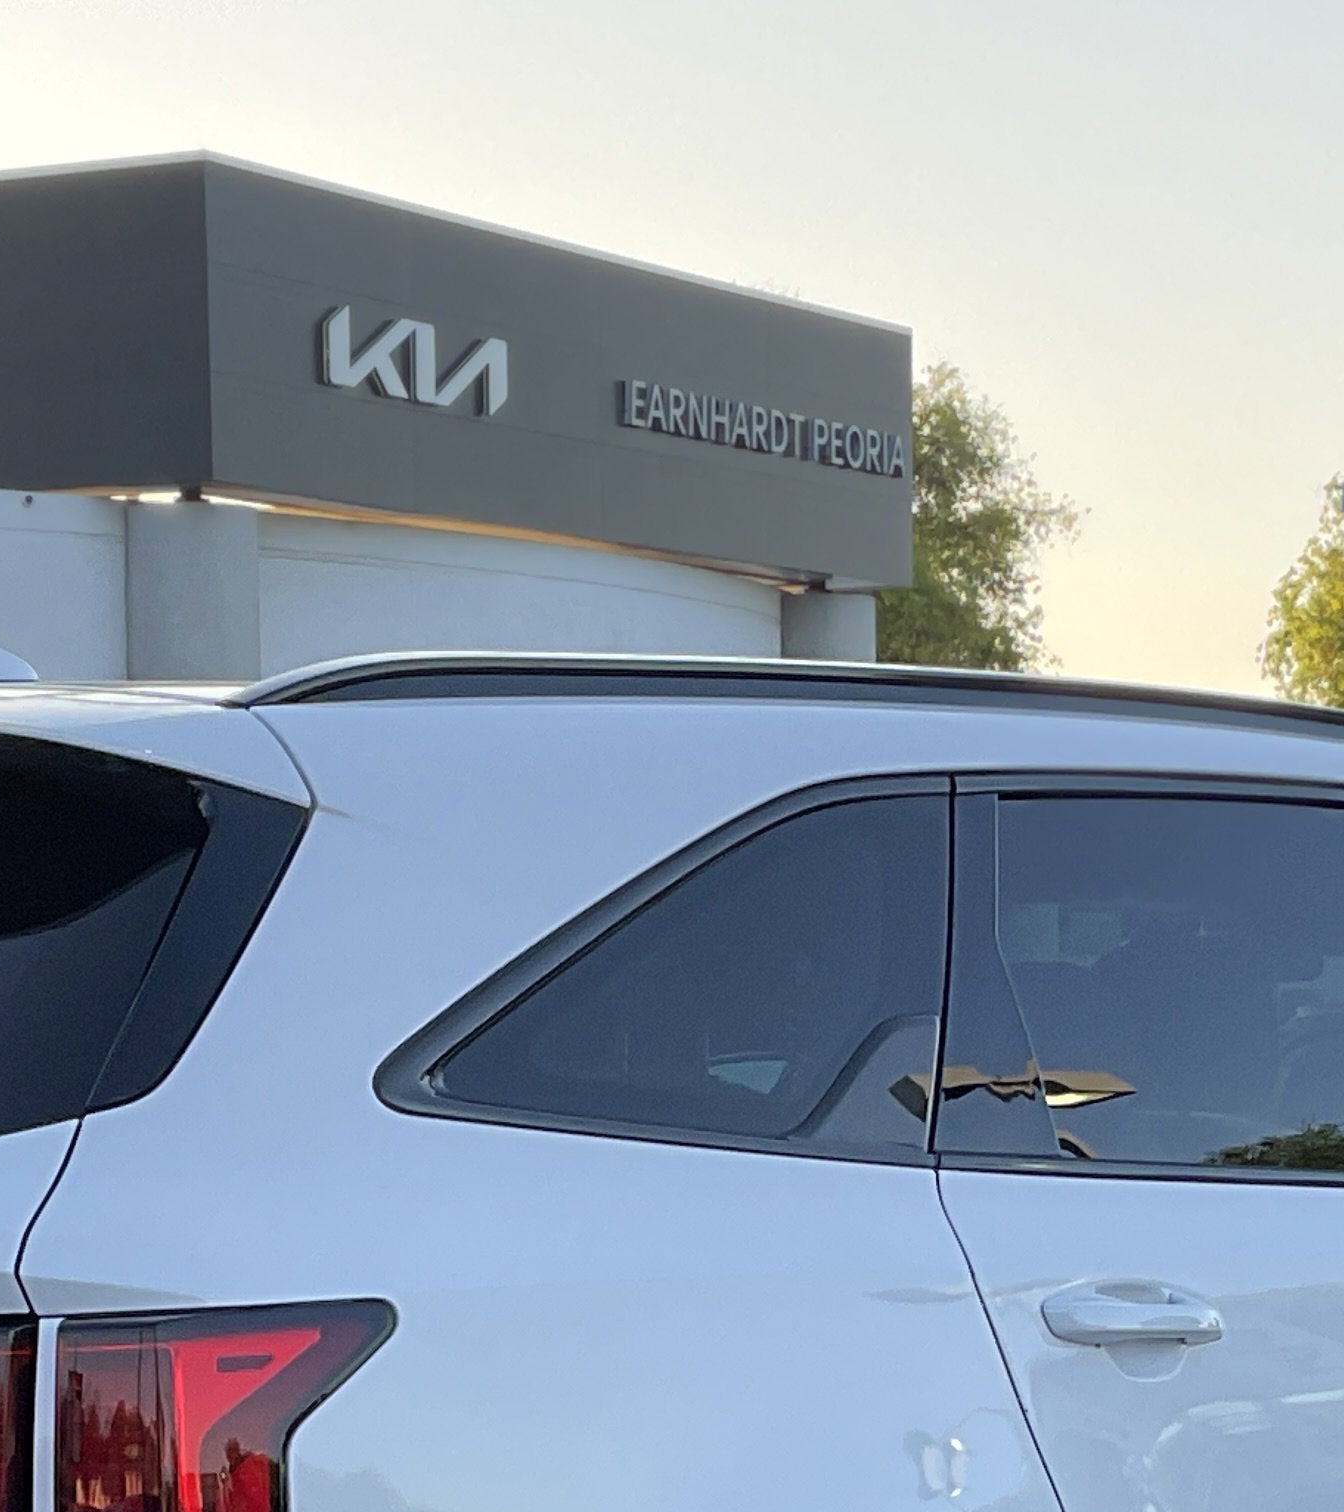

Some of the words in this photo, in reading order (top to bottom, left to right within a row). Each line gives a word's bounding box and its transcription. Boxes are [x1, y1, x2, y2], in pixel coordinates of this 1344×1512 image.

[322, 304, 508, 416] KIA
[625, 379, 804, 454] EARNHARDT
[812, 418, 905, 478] PEORIA
